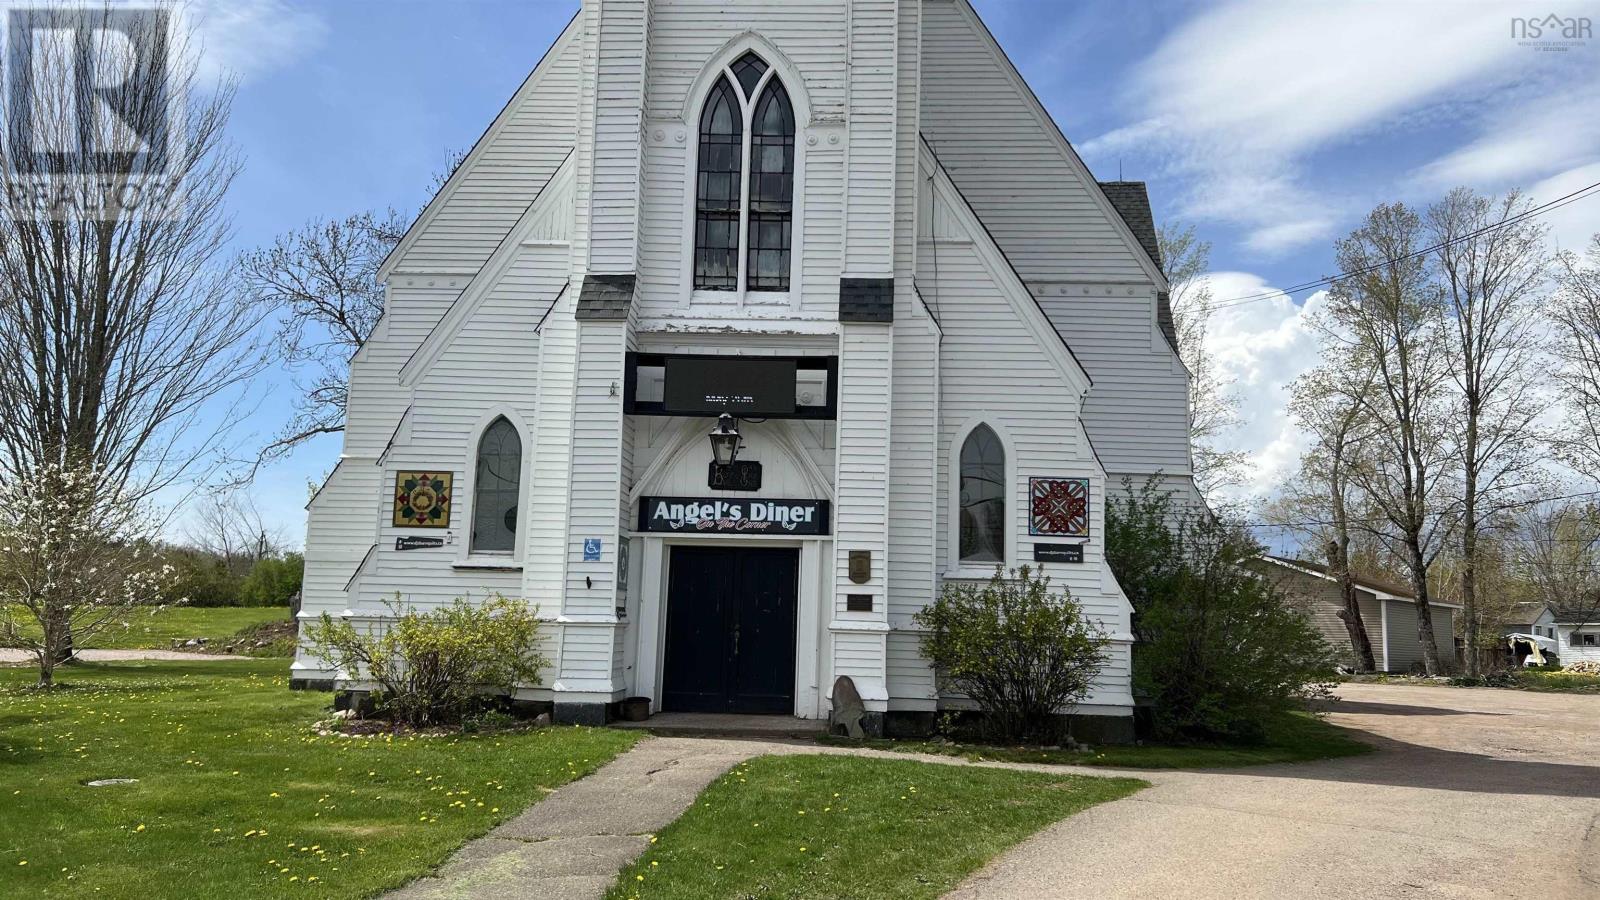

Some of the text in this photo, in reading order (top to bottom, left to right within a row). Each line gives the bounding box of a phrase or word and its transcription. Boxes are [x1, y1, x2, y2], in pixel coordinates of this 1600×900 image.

[653, 501, 815, 527] Angel's Diner
[696, 518, 714, 531] On
[735, 518, 772, 531] Corner
